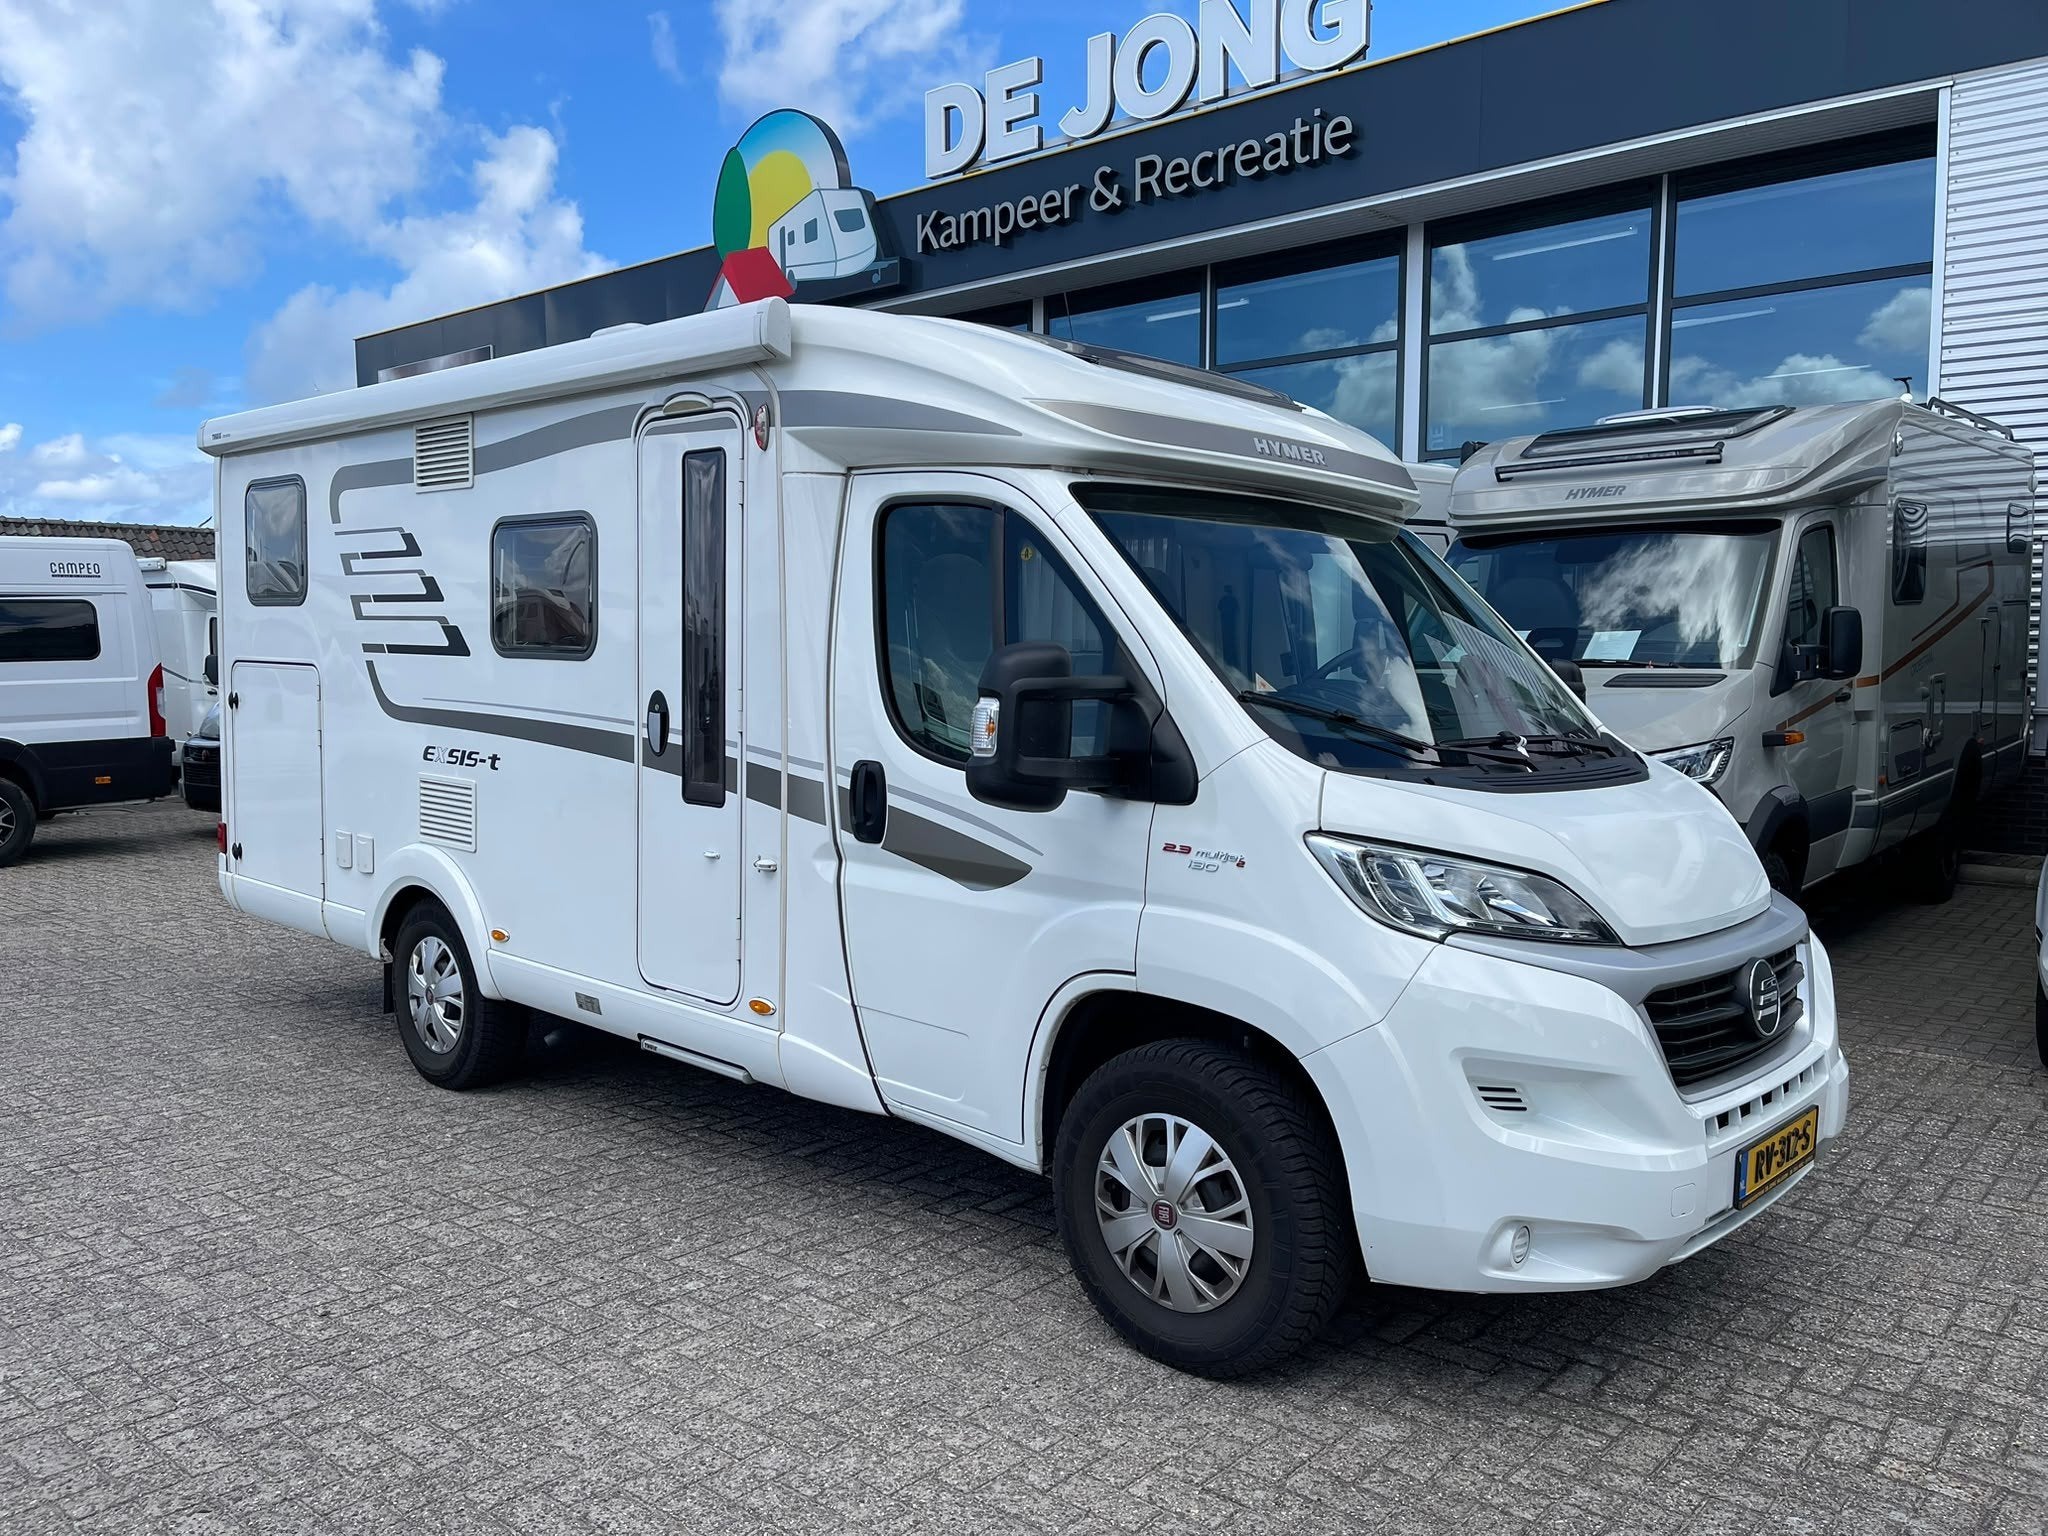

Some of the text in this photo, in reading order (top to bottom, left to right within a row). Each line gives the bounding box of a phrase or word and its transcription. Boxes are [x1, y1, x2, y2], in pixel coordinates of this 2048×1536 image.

[924, 0, 1371, 180] DE JONG
[916, 107, 1354, 254] Kampeer & Recreatie
[1252, 437, 1327, 466] HYMER
[1564, 485, 1627, 500] HYMER
[50, 562, 101, 575] CAMPEO
[423, 745, 501, 771] EXSIS-t
[1162, 842, 1192, 855] 2.3
[1187, 859, 1220, 874] 130
[1754, 1120, 1811, 1184] RV-312-S
[1158, 1204, 1170, 1225] FIAT
